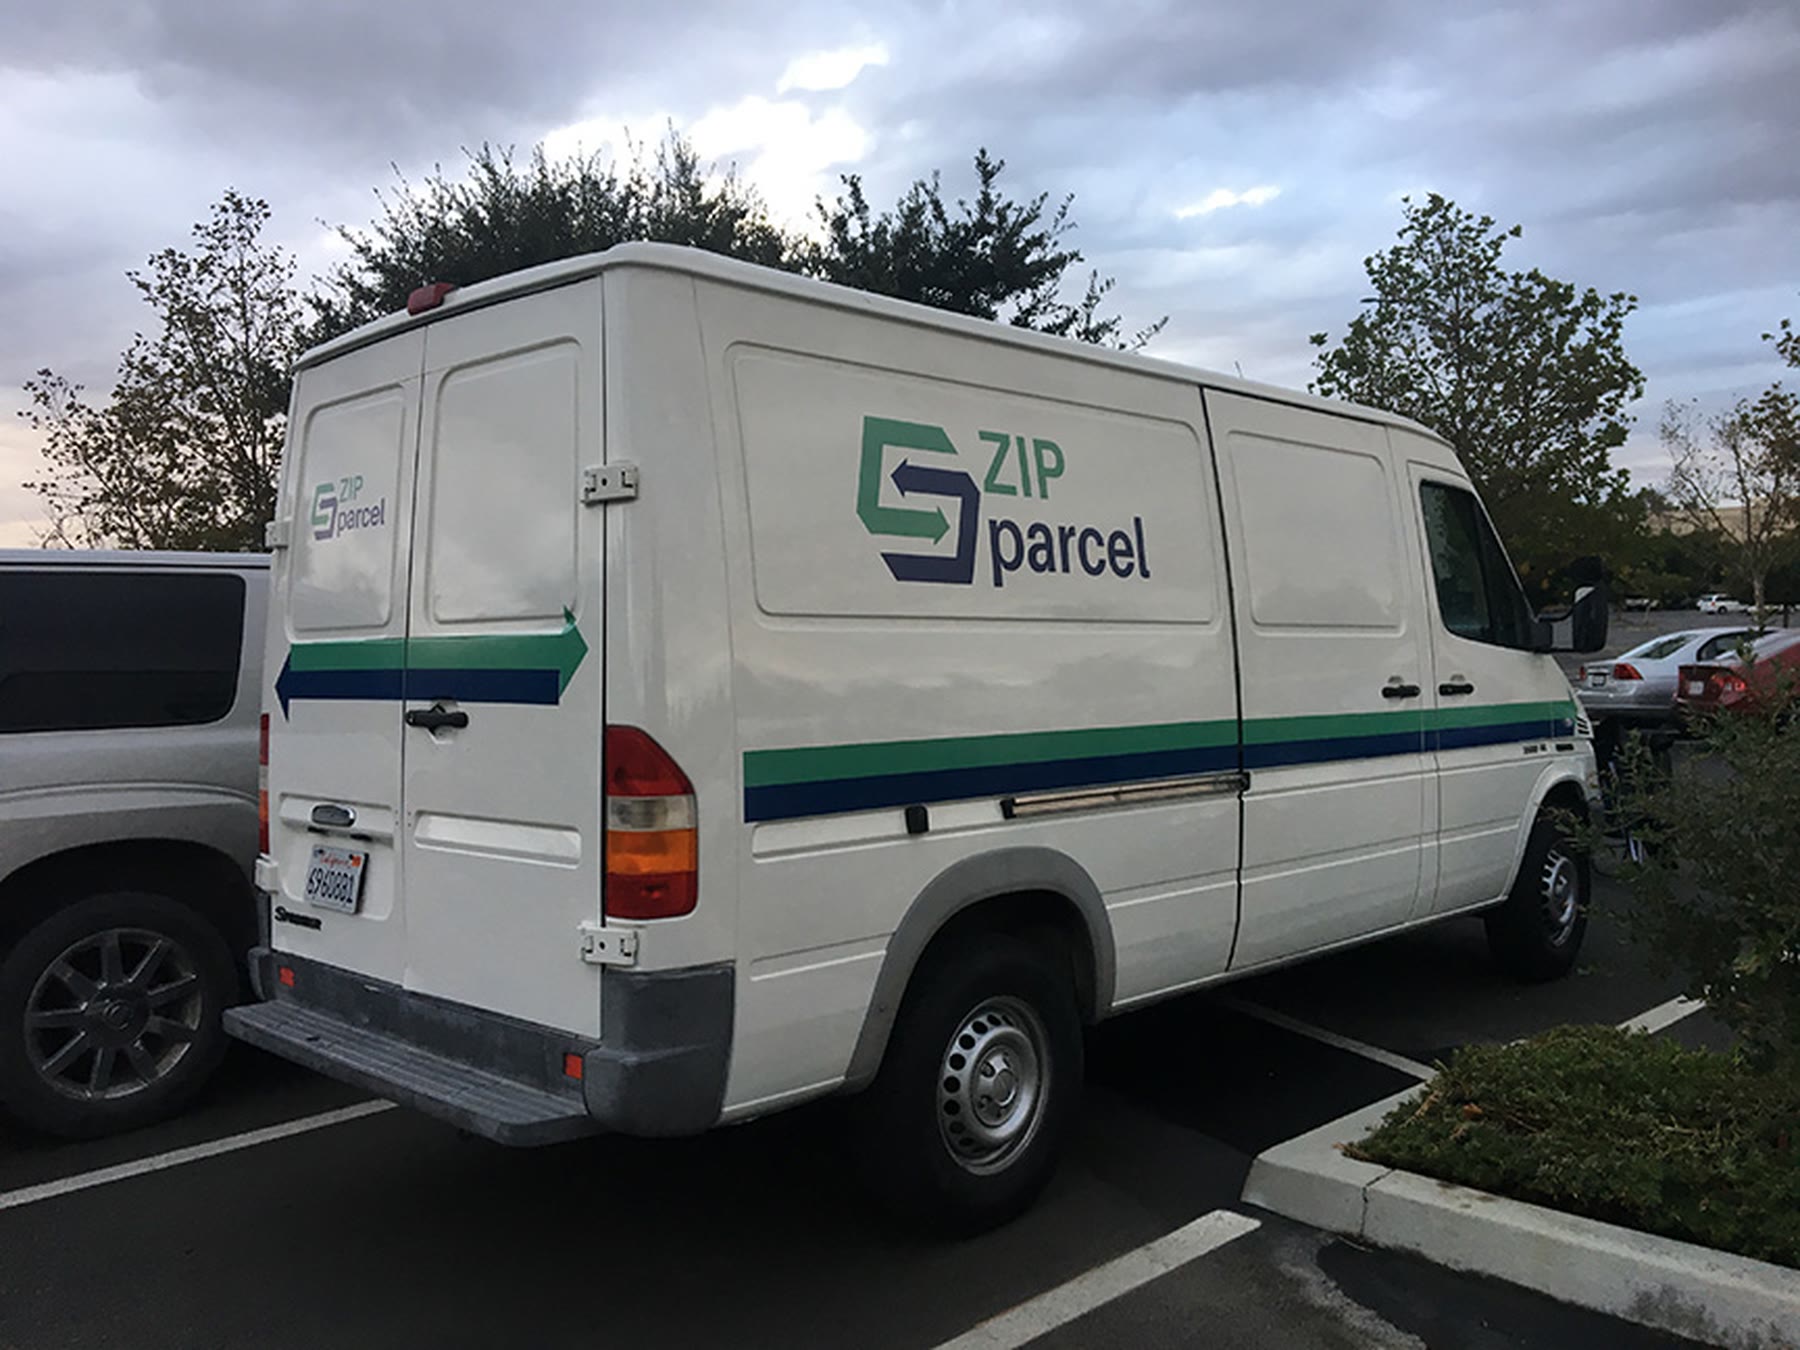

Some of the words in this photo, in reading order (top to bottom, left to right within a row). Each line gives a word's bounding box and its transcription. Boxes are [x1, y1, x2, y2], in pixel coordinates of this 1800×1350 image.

[339, 474, 364, 503] ZIP
[978, 430, 1066, 500] ZIP
[337, 497, 385, 538] parcel
[988, 516, 1151, 588] parcel
